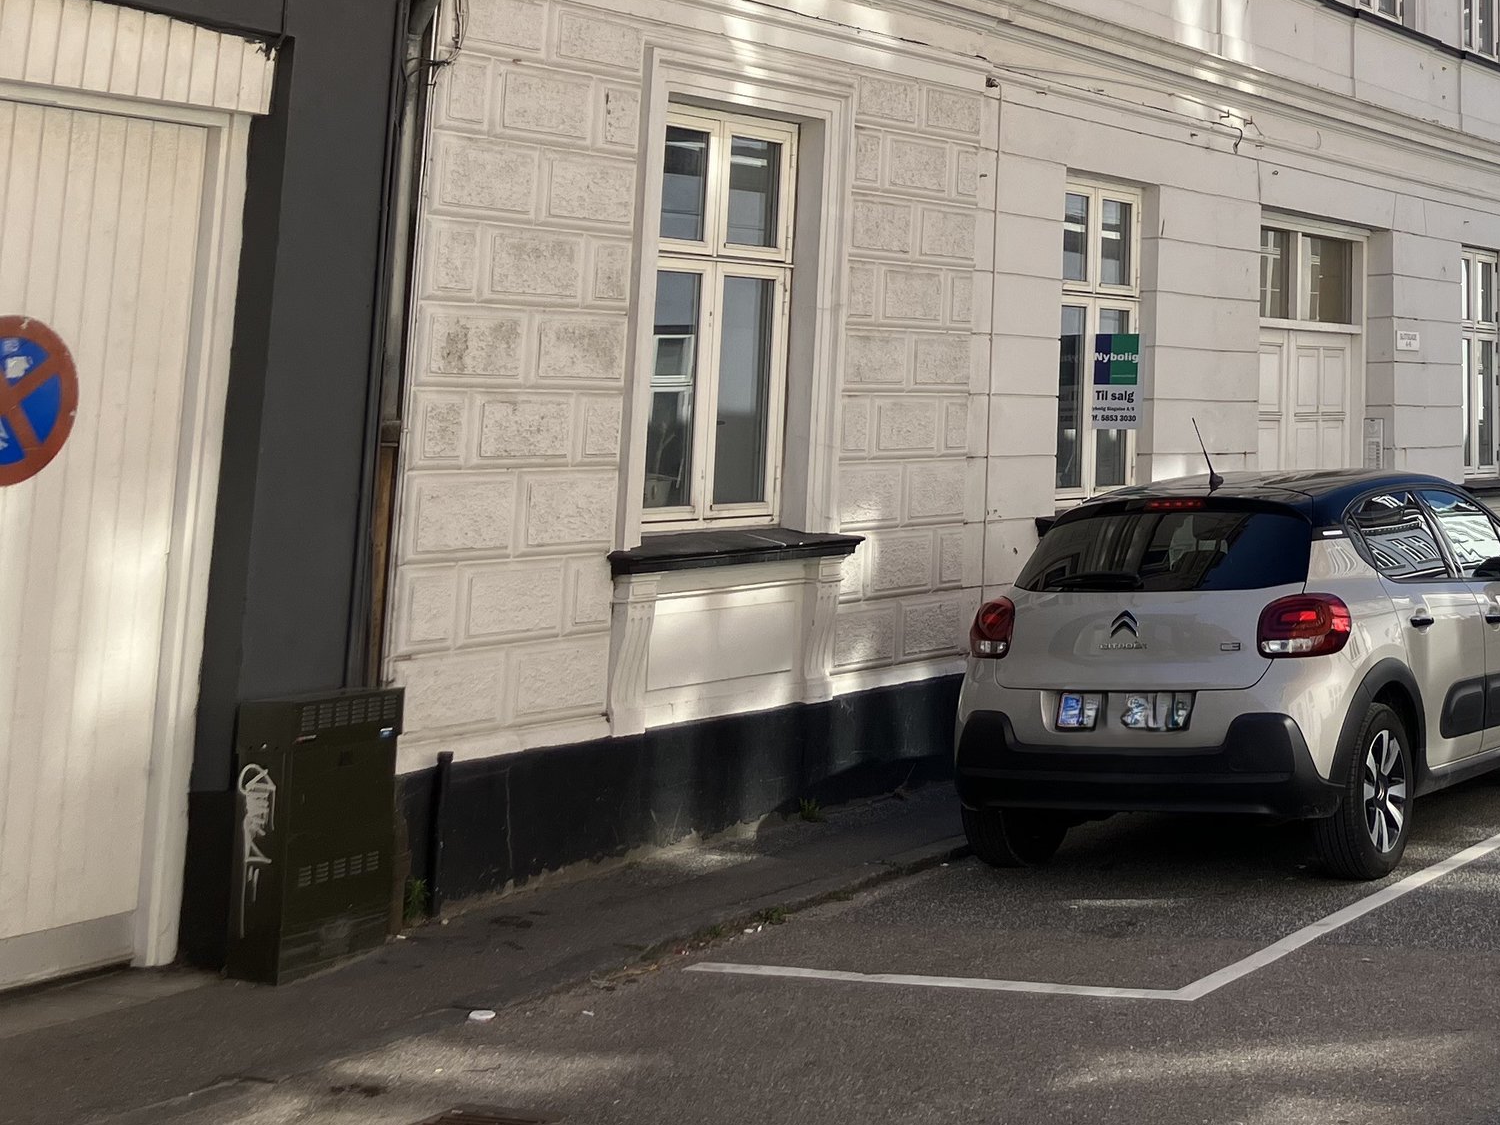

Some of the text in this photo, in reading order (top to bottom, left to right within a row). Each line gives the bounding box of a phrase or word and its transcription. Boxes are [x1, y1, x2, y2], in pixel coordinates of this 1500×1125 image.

[1094, 352, 1139, 363] Nybolig
[1095, 390, 1135, 403] Til salg
